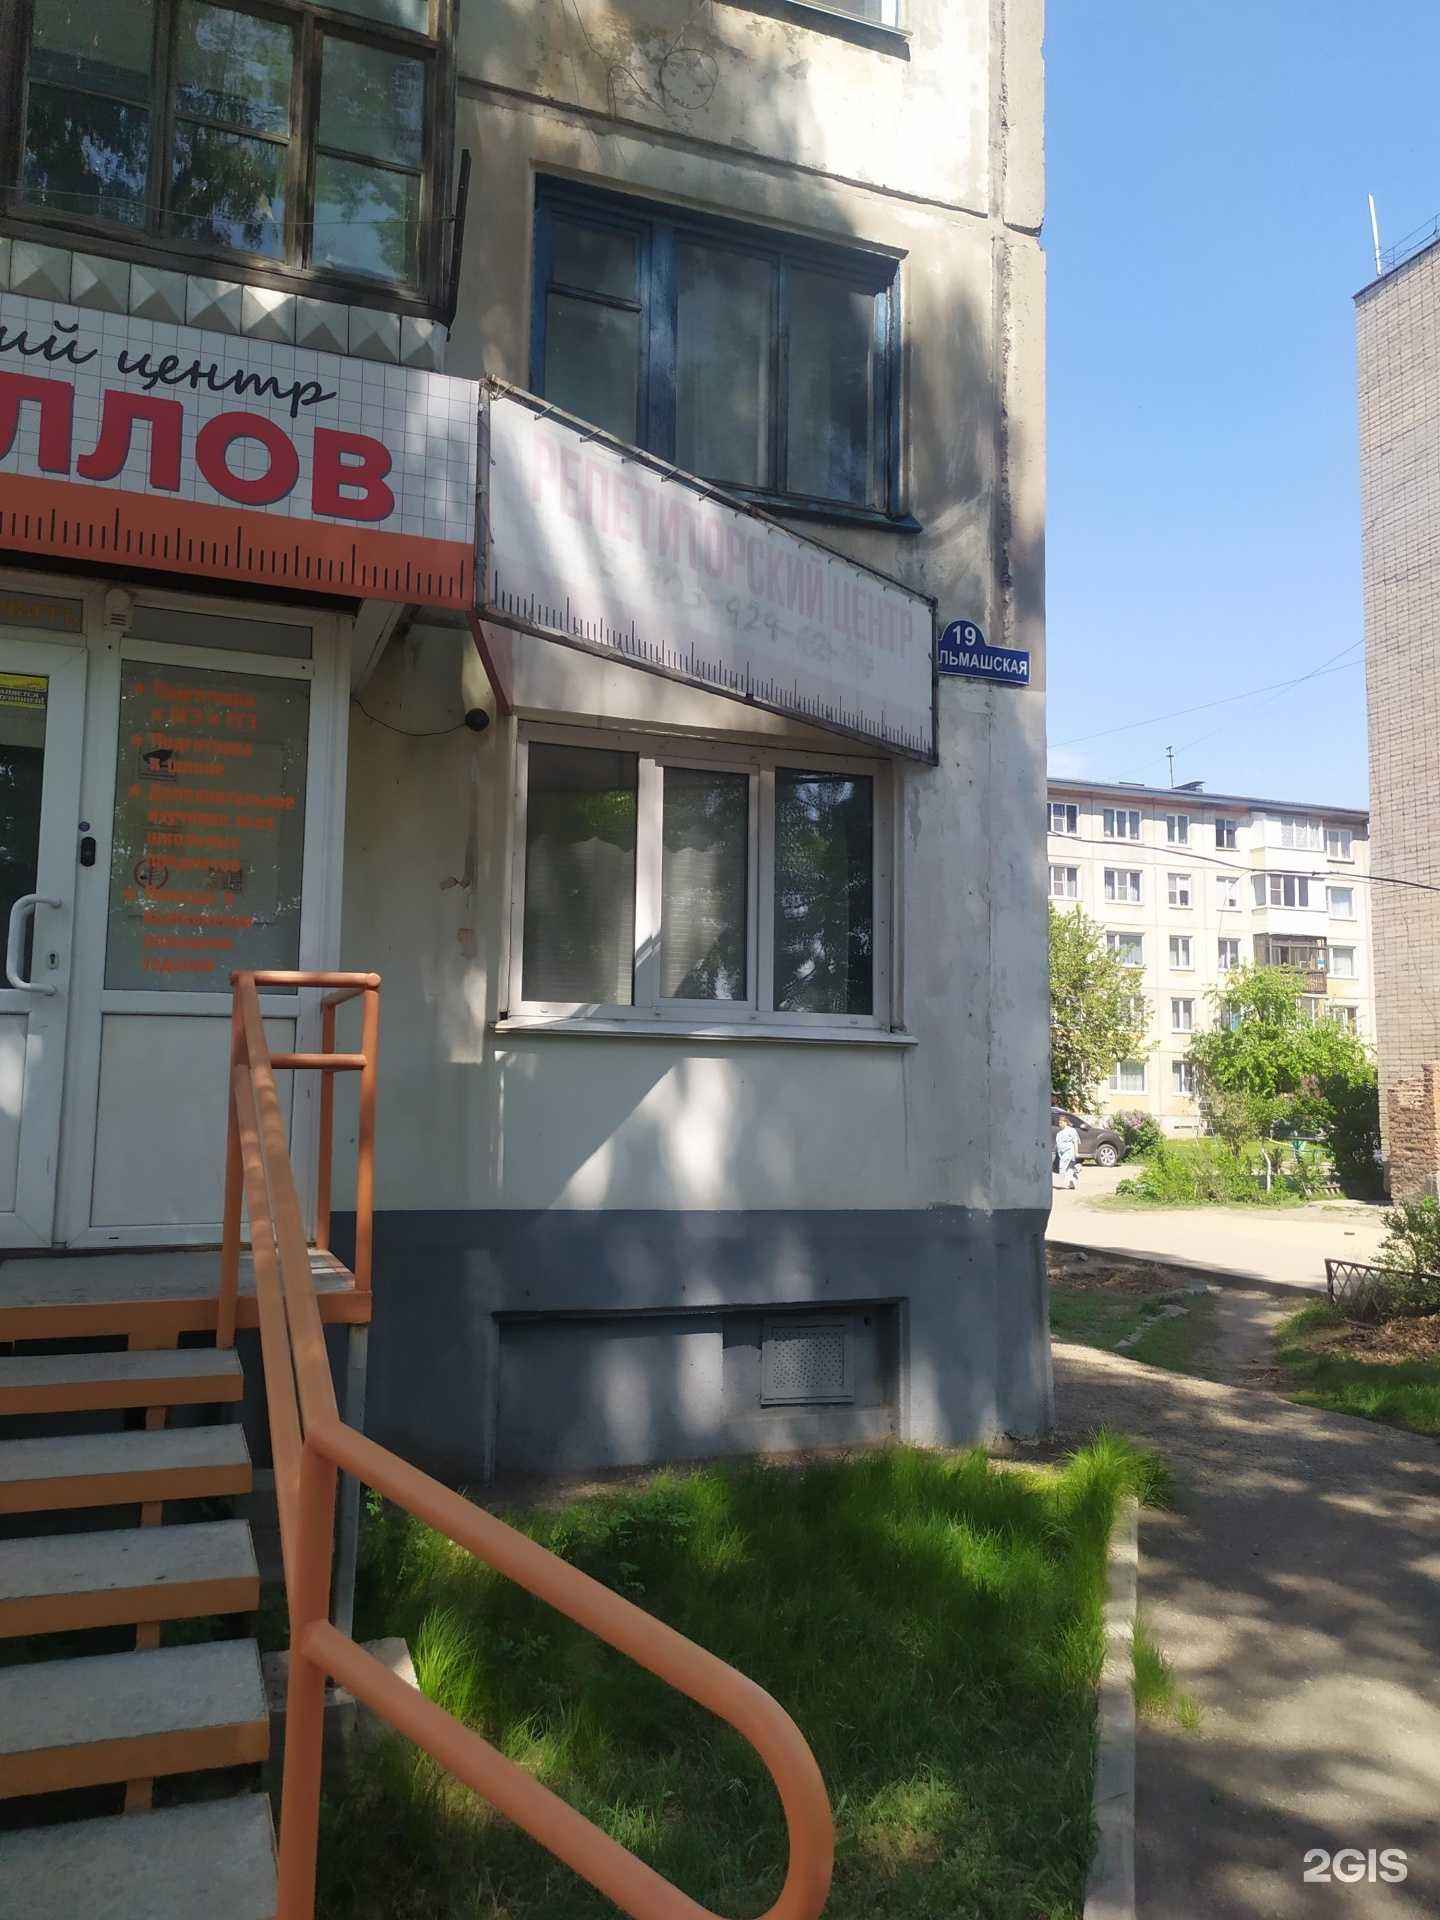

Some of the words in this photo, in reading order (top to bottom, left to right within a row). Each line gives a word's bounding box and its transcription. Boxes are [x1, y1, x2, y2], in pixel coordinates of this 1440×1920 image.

[117, 350, 338, 418] центр
[532, 434, 827, 624] РЕПЕТИТОРСКИЙ
[830, 574, 914, 653] ЦЕНТР
[952, 625, 977, 646] 19
[940, 649, 1028, 675] ЛЬМАШСКАЯ
